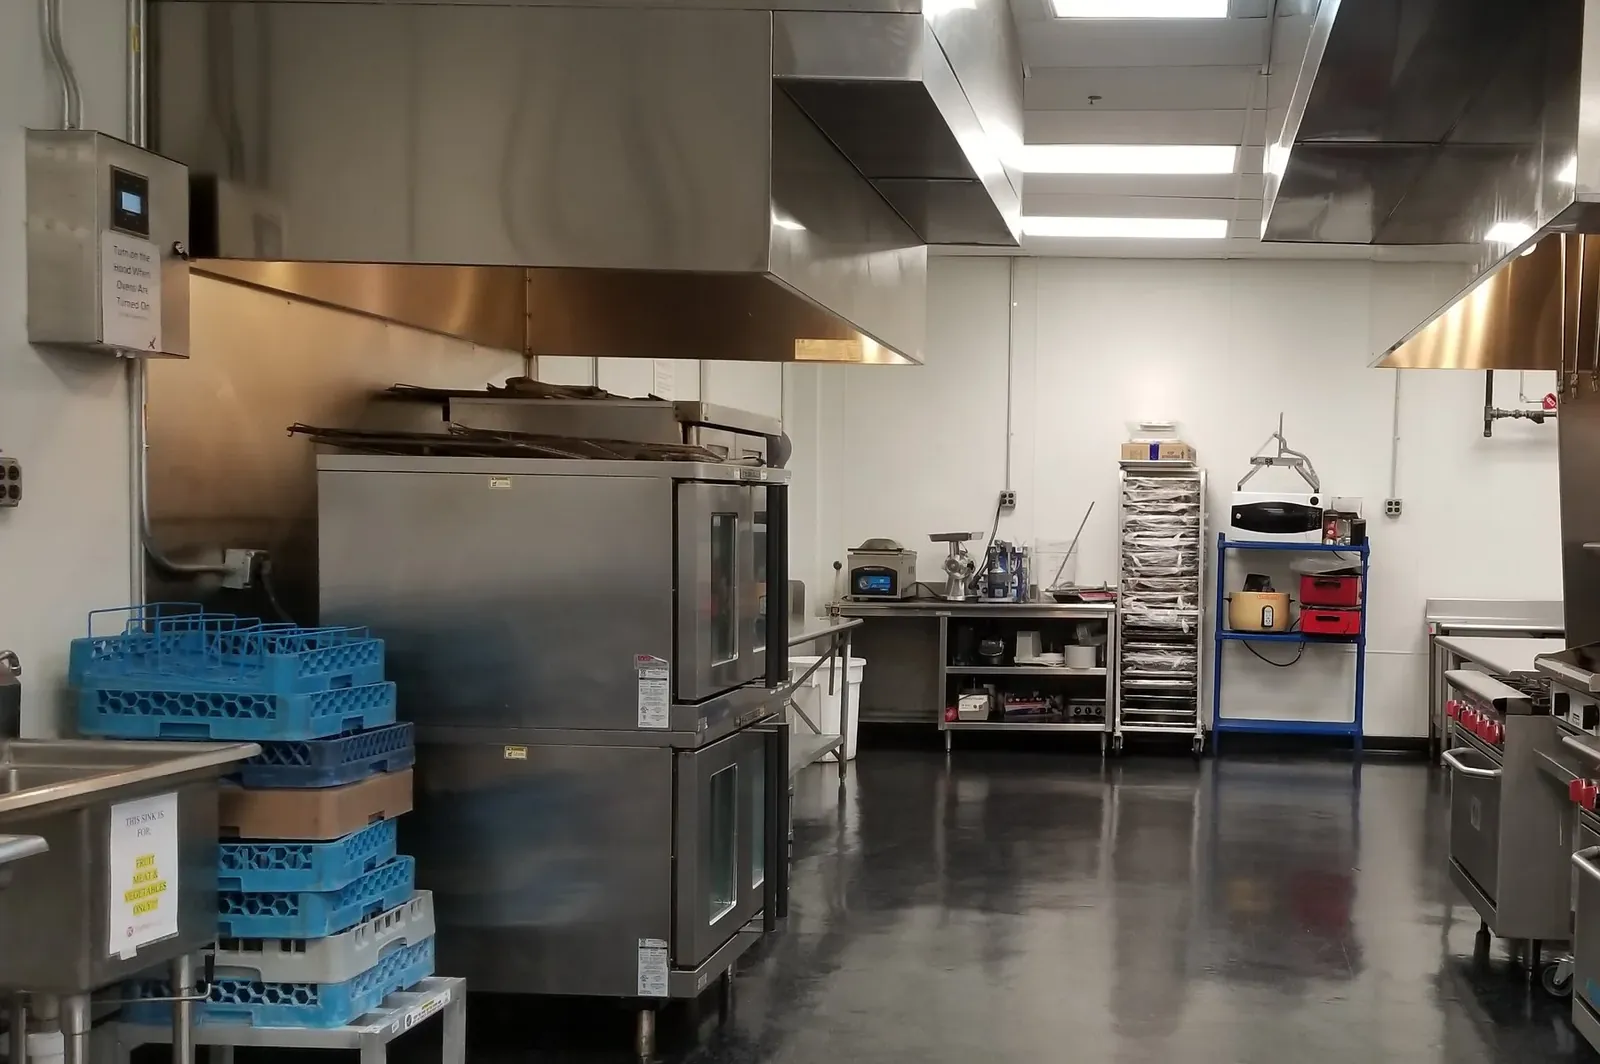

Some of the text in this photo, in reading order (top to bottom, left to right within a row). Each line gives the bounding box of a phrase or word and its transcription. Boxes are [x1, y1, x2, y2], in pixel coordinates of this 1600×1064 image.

[113, 245, 129, 257] Turn
[126, 810, 165, 827] THIS SINK IS
[136, 855, 155, 869] FRUIT
[132, 872, 151, 885] MEAT
[124, 881, 167, 902] VEGETABLES
